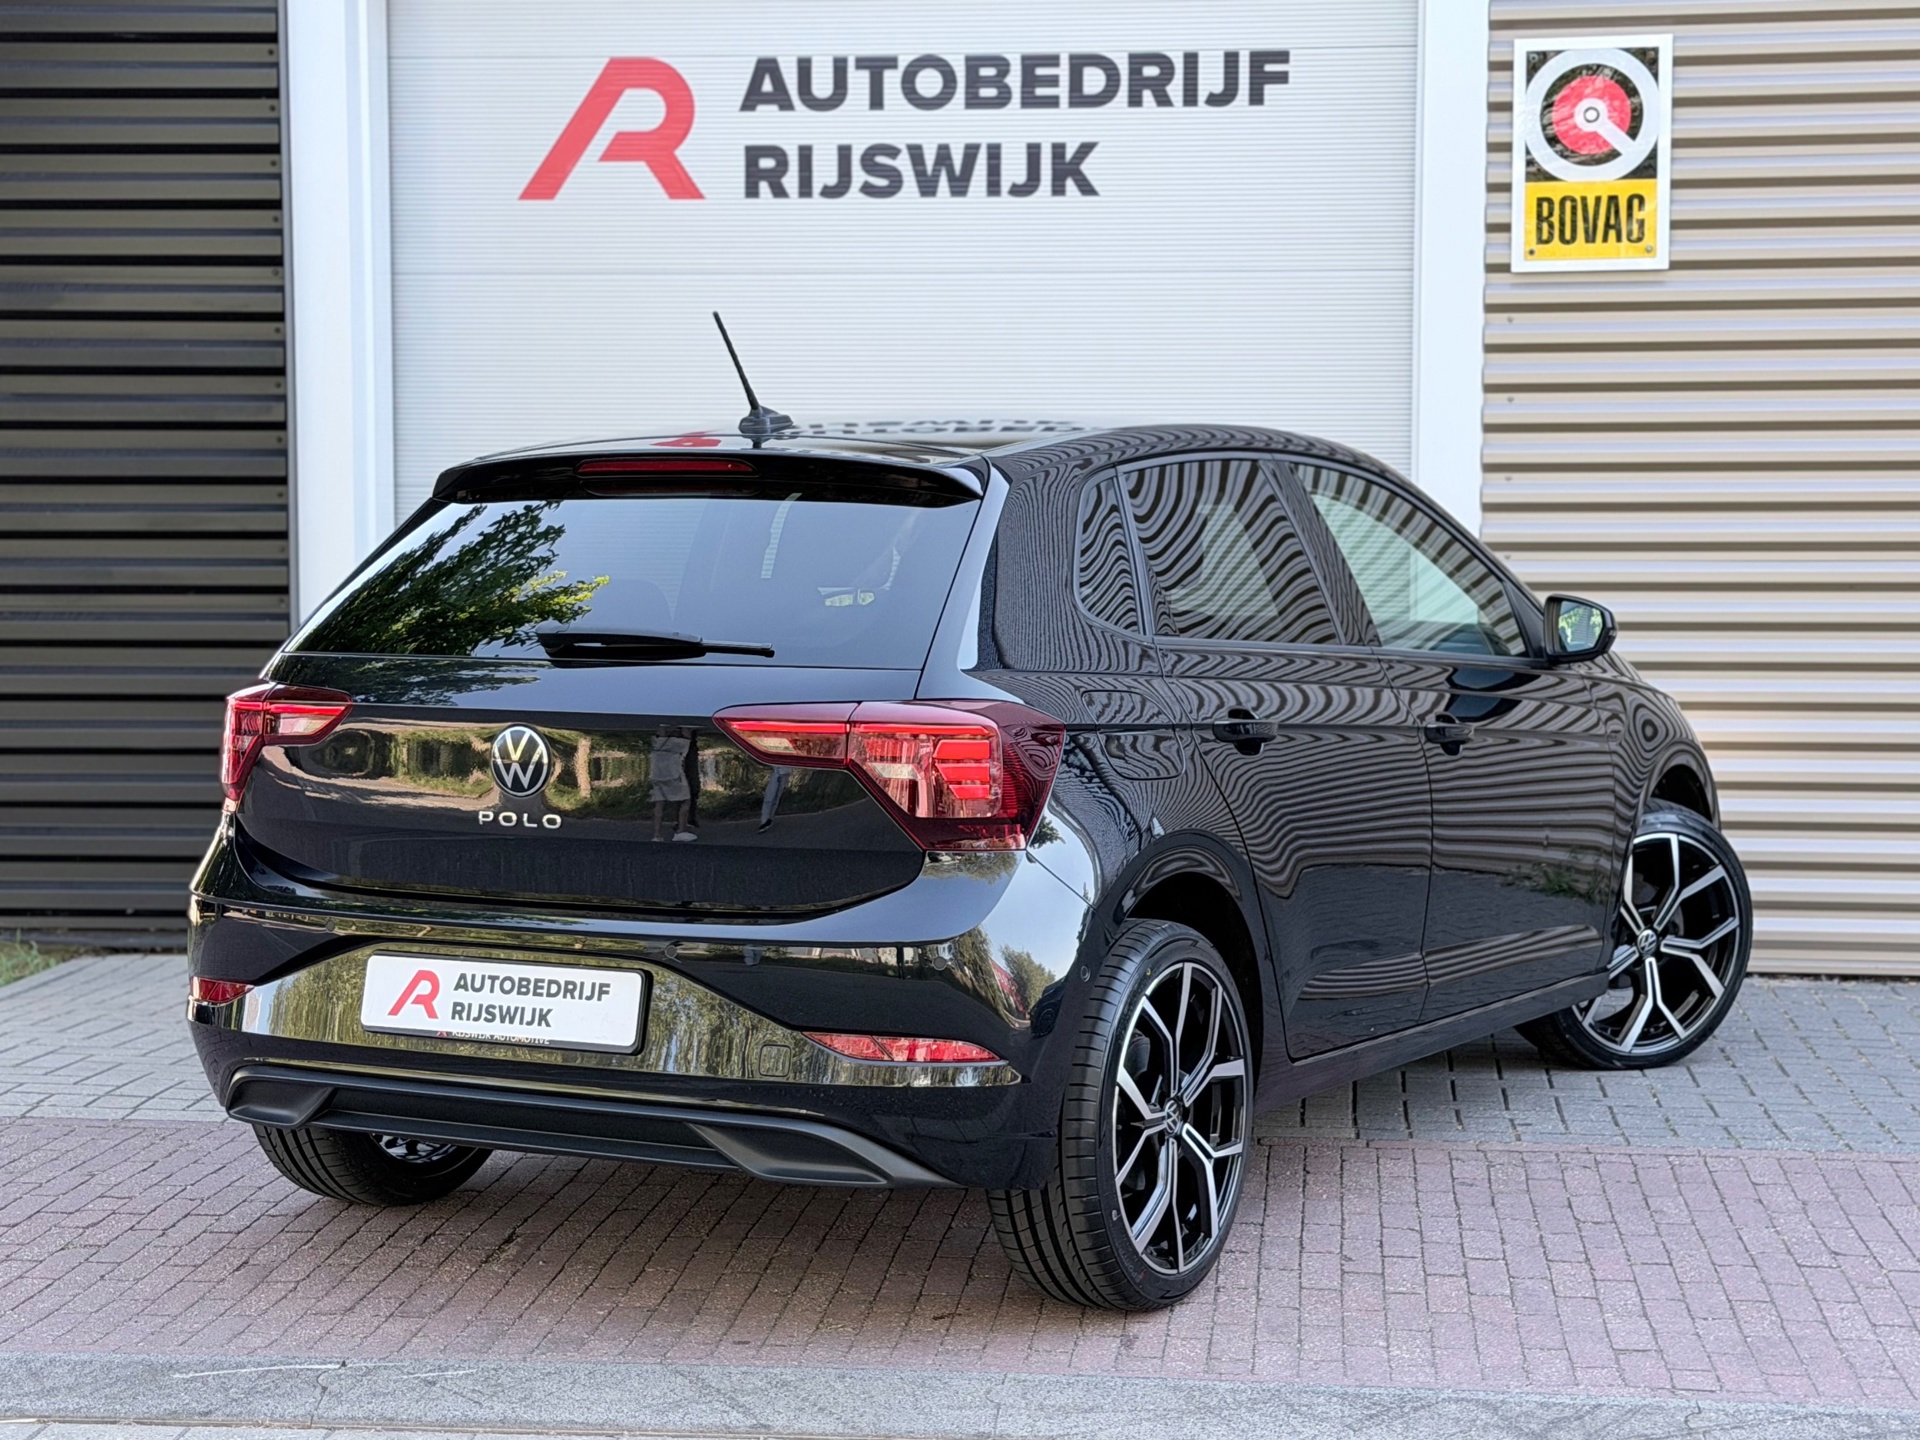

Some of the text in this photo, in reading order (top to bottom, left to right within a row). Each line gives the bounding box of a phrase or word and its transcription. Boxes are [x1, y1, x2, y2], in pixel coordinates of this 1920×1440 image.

[739, 50, 1290, 112] AUTOBEDRIJF
[744, 142, 1099, 199] RIJSWIJK
[1535, 193, 1646, 245] BOVAG
[478, 810, 562, 829] POLO
[453, 972, 612, 1002] AUTOBEDRIJF
[450, 1001, 554, 1028] RIJSWIJK
